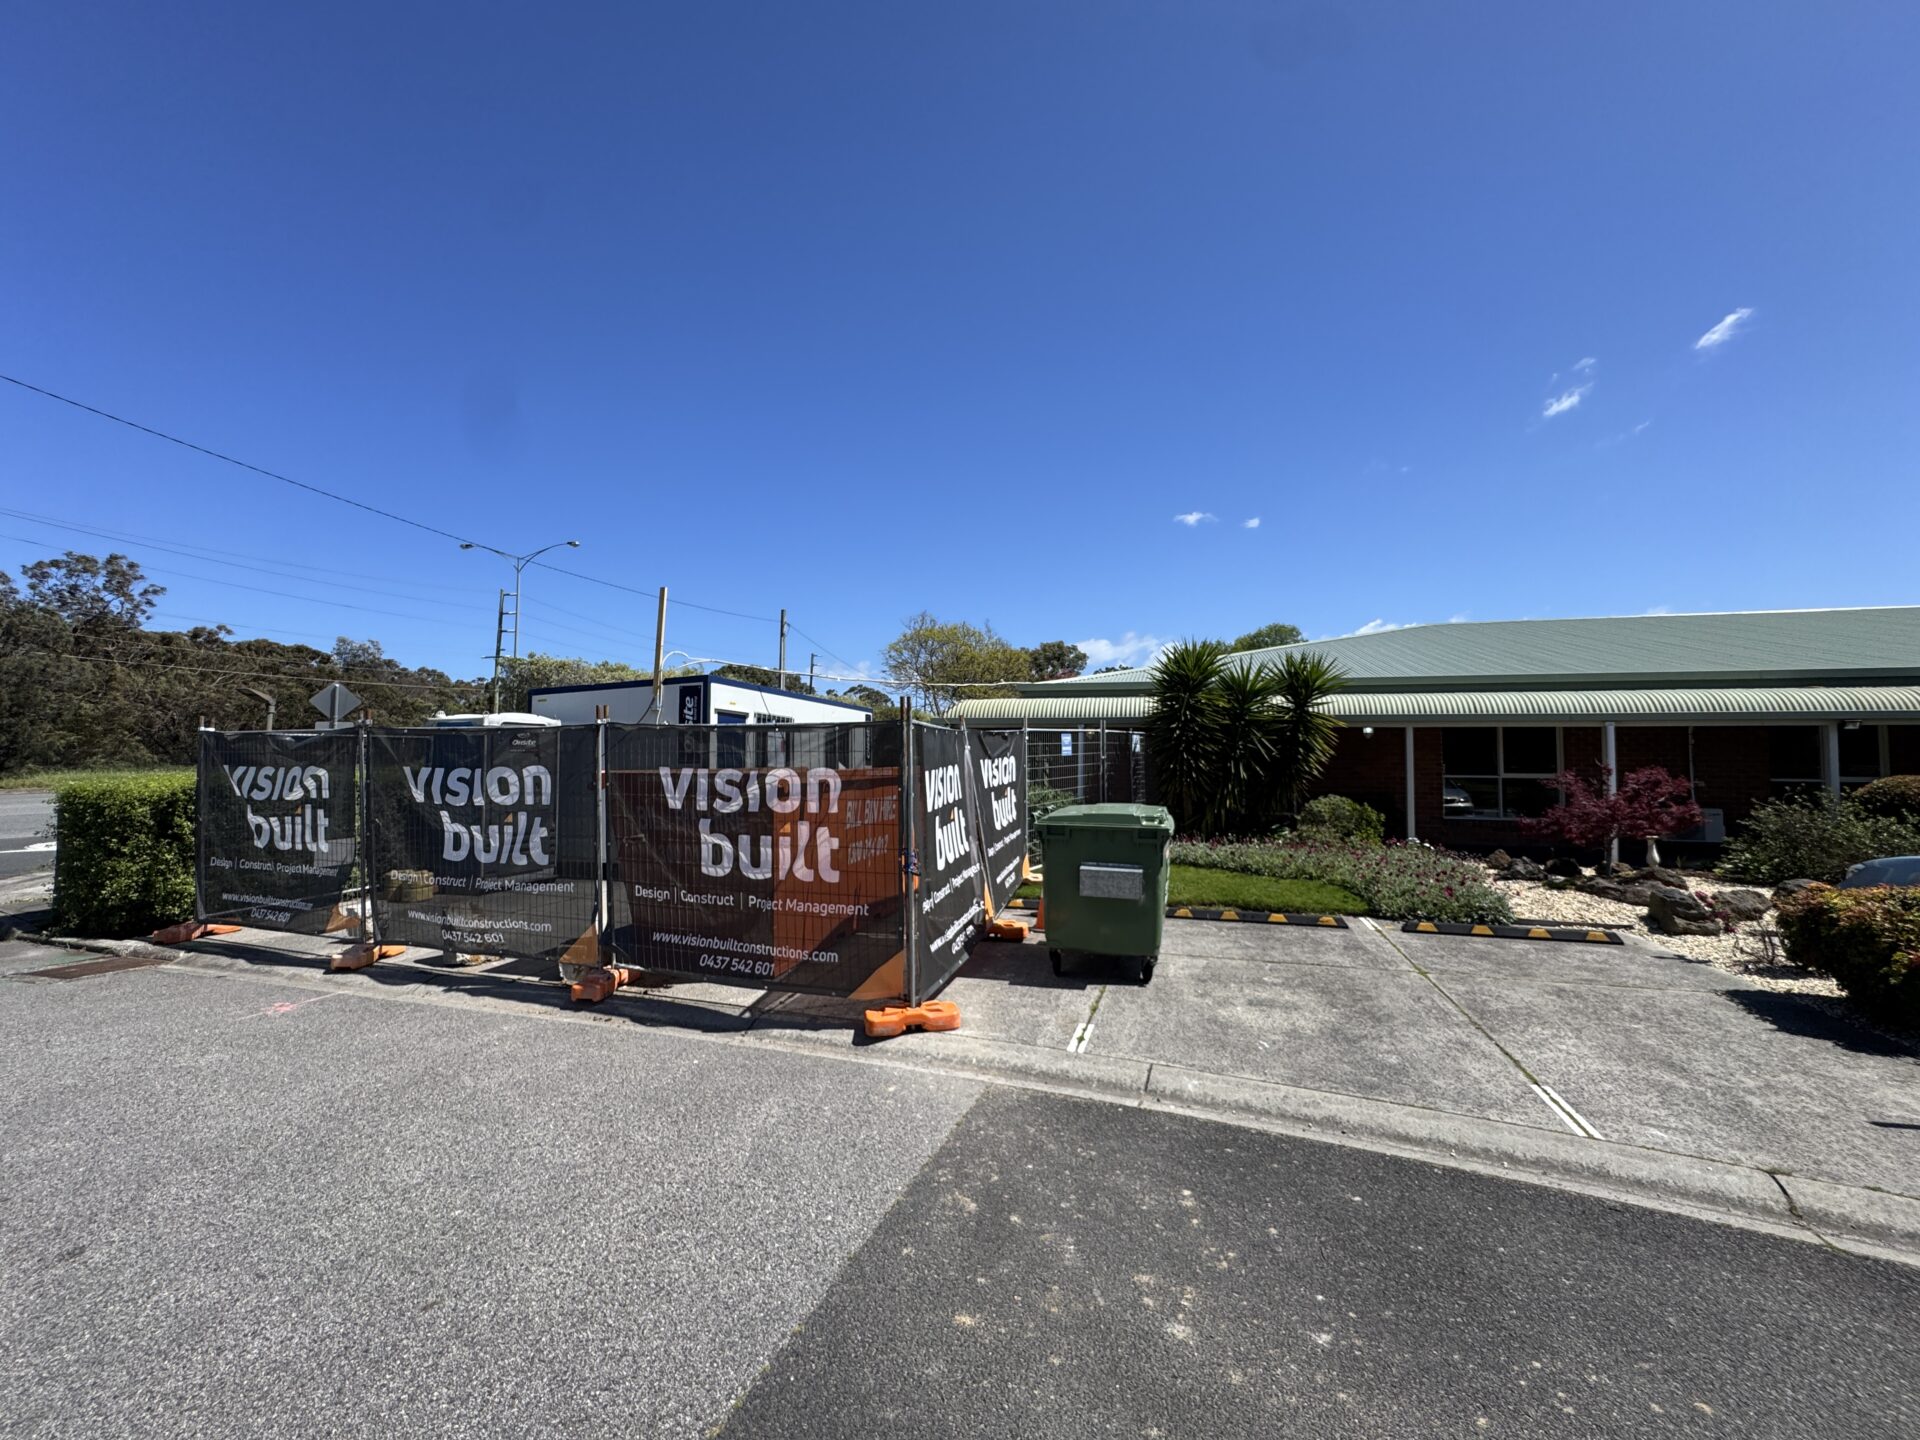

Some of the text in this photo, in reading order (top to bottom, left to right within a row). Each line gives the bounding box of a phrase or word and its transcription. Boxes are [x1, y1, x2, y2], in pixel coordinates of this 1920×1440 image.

[991, 786, 1017, 831] built
[247, 803, 329, 853] built
[439, 810, 549, 866] built
[935, 806, 969, 871] built
[210, 856, 233, 869] Design
[276, 863, 302, 875] Project
[699, 818, 840, 883] built
[390, 870, 575, 894] Design Construct Project Management
[635, 885, 670, 902] Design
[680, 890, 734, 906] Construct
[785, 898, 869, 917] Management
[441, 929, 504, 944] 0437 542 601
[652, 931, 839, 963] www.visionbuiltconstructions.com
[699, 953, 775, 976] 0437 542 601
